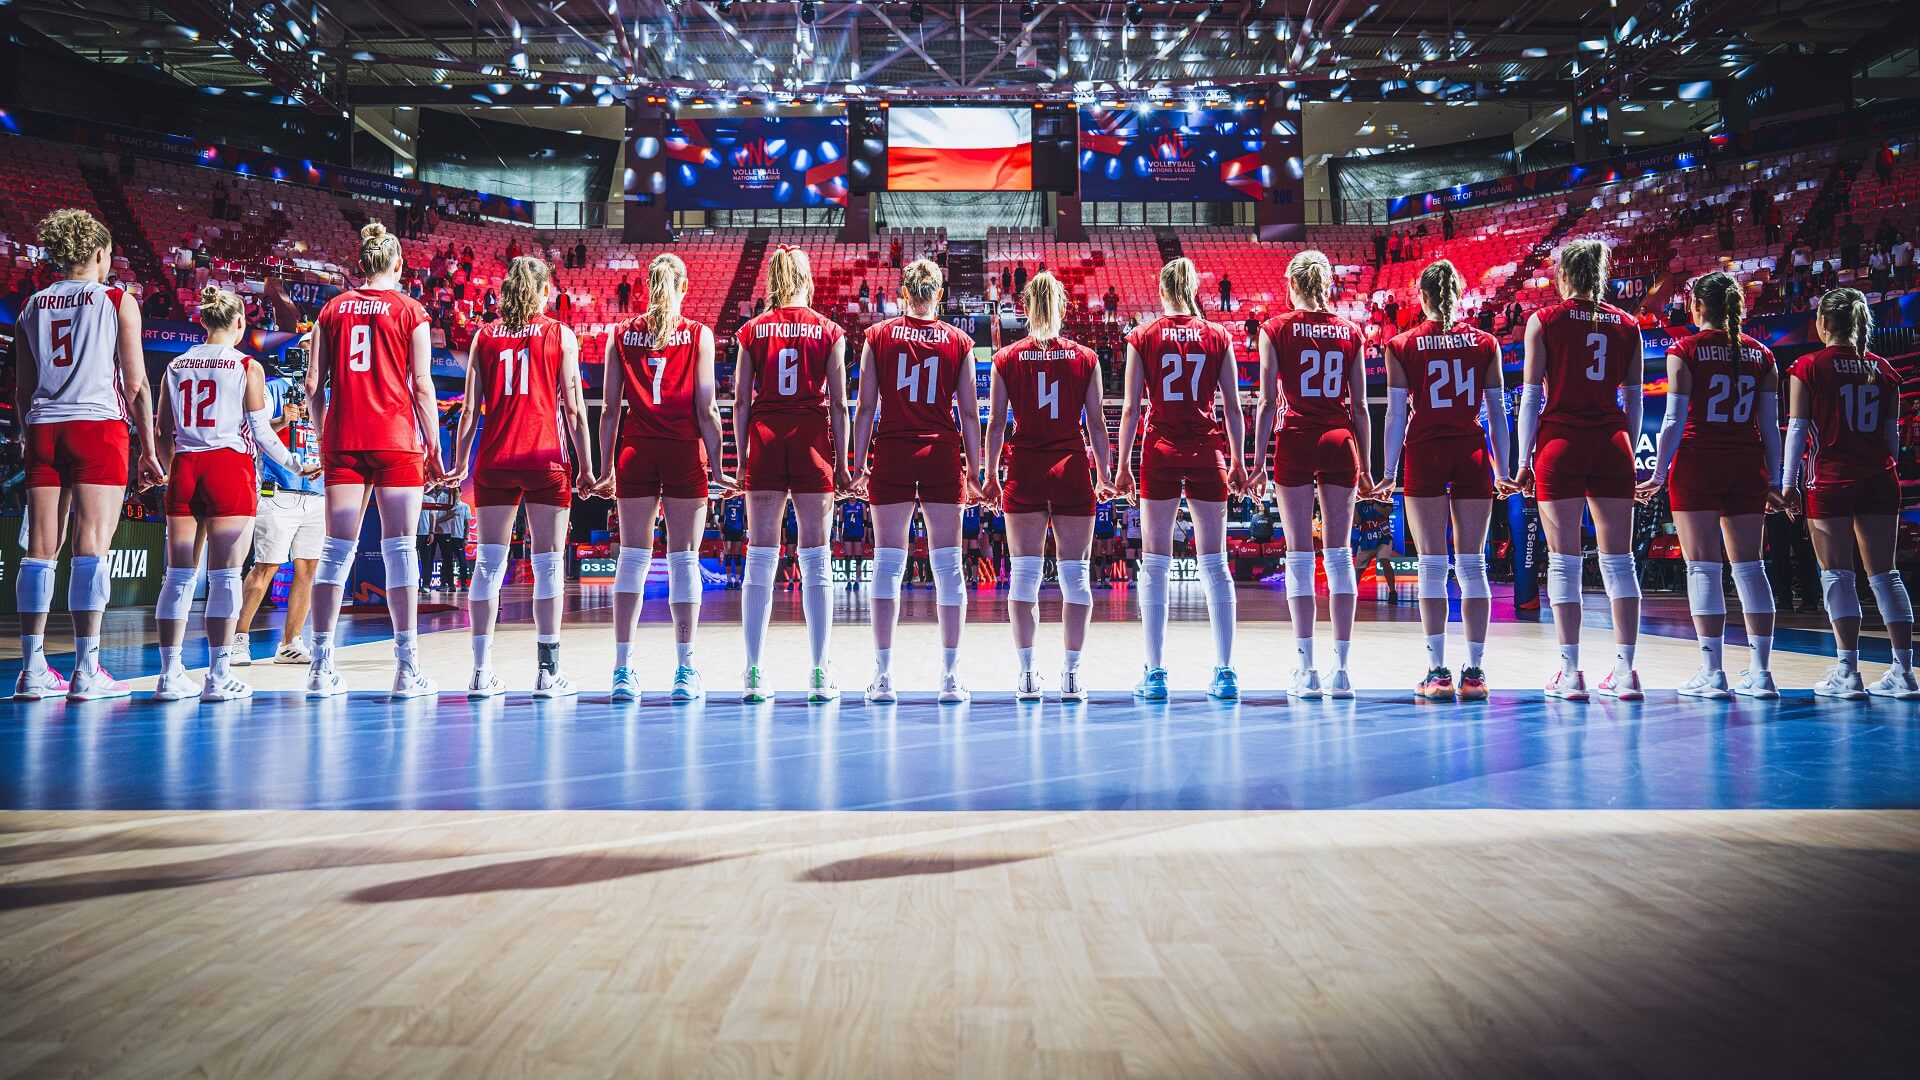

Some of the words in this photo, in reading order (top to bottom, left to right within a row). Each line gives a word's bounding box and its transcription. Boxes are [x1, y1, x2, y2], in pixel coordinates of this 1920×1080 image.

[119, 136, 143, 146] PART
[146, 140, 159, 149] OF
[163, 143, 180, 153] THE
[182, 146, 209, 159] GAME
[1626, 161, 1637, 170] BE
[1639, 157, 1660, 167] PART
[1663, 154, 1676, 163] OF
[1678, 151, 1695, 161] THE
[338, 174, 348, 182] BE
[350, 177, 371, 187] PART
[372, 181, 382, 189] OF
[384, 183, 399, 193] THE
[400, 186, 423, 196] GAME
[1432, 198, 1441, 206] BE
[1443, 194, 1461, 204] PART
[1463, 191, 1472, 200] OF
[1475, 188, 1489, 197] THE
[1490, 184, 1513, 194] GAME
[293, 283, 320, 303] 207
[1617, 279, 1643, 299] 209
[34, 291, 94, 310] KORNELUK
[339, 300, 392, 316] STYSIAK
[953, 317, 975, 334] 208
[1570, 309, 1621, 325] ALAGRSKA
[161, 331, 176, 340] OF
[178, 332, 199, 343] THE
[623, 330, 692, 347] GAŁKSKA
[756, 322, 822, 339] WITKOWSKA
[891, 325, 950, 344] MĘDRZYK
[1161, 328, 1202, 342] PACAK
[1292, 323, 1350, 340] PIASECKA
[51, 319, 73, 367] 5
[349, 325, 371, 372] 9
[1416, 332, 1478, 351] DAMASKE
[1644, 338, 1658, 348] HE
[1018, 349, 1076, 361] KOWALEWSKA
[1586, 332, 1607, 381] 3
[1697, 345, 1763, 364] WENESKA
[173, 359, 236, 370] SZCZYGŁOWSKA
[499, 347, 529, 395] 11
[778, 348, 798, 396] 6
[1300, 349, 1344, 398] 28
[648, 357, 667, 405] 7
[896, 352, 939, 404] 41
[1161, 353, 1206, 402] 27
[1427, 359, 1475, 409] 24
[178, 378, 217, 427] 12
[1038, 371, 1059, 419] 4
[1706, 373, 1756, 423] 26
[1840, 383, 1880, 432] 16
[730, 507, 737, 518] 3
[850, 513, 856, 523] 4
[1099, 511, 1109, 521] 21
[1132, 518, 1141, 528] 12
[1367, 520, 1378, 528] TV
[1525, 533, 1536, 569] Senoh
[107, 549, 148, 579] TALYA
[581, 563, 616, 572] 03:3
